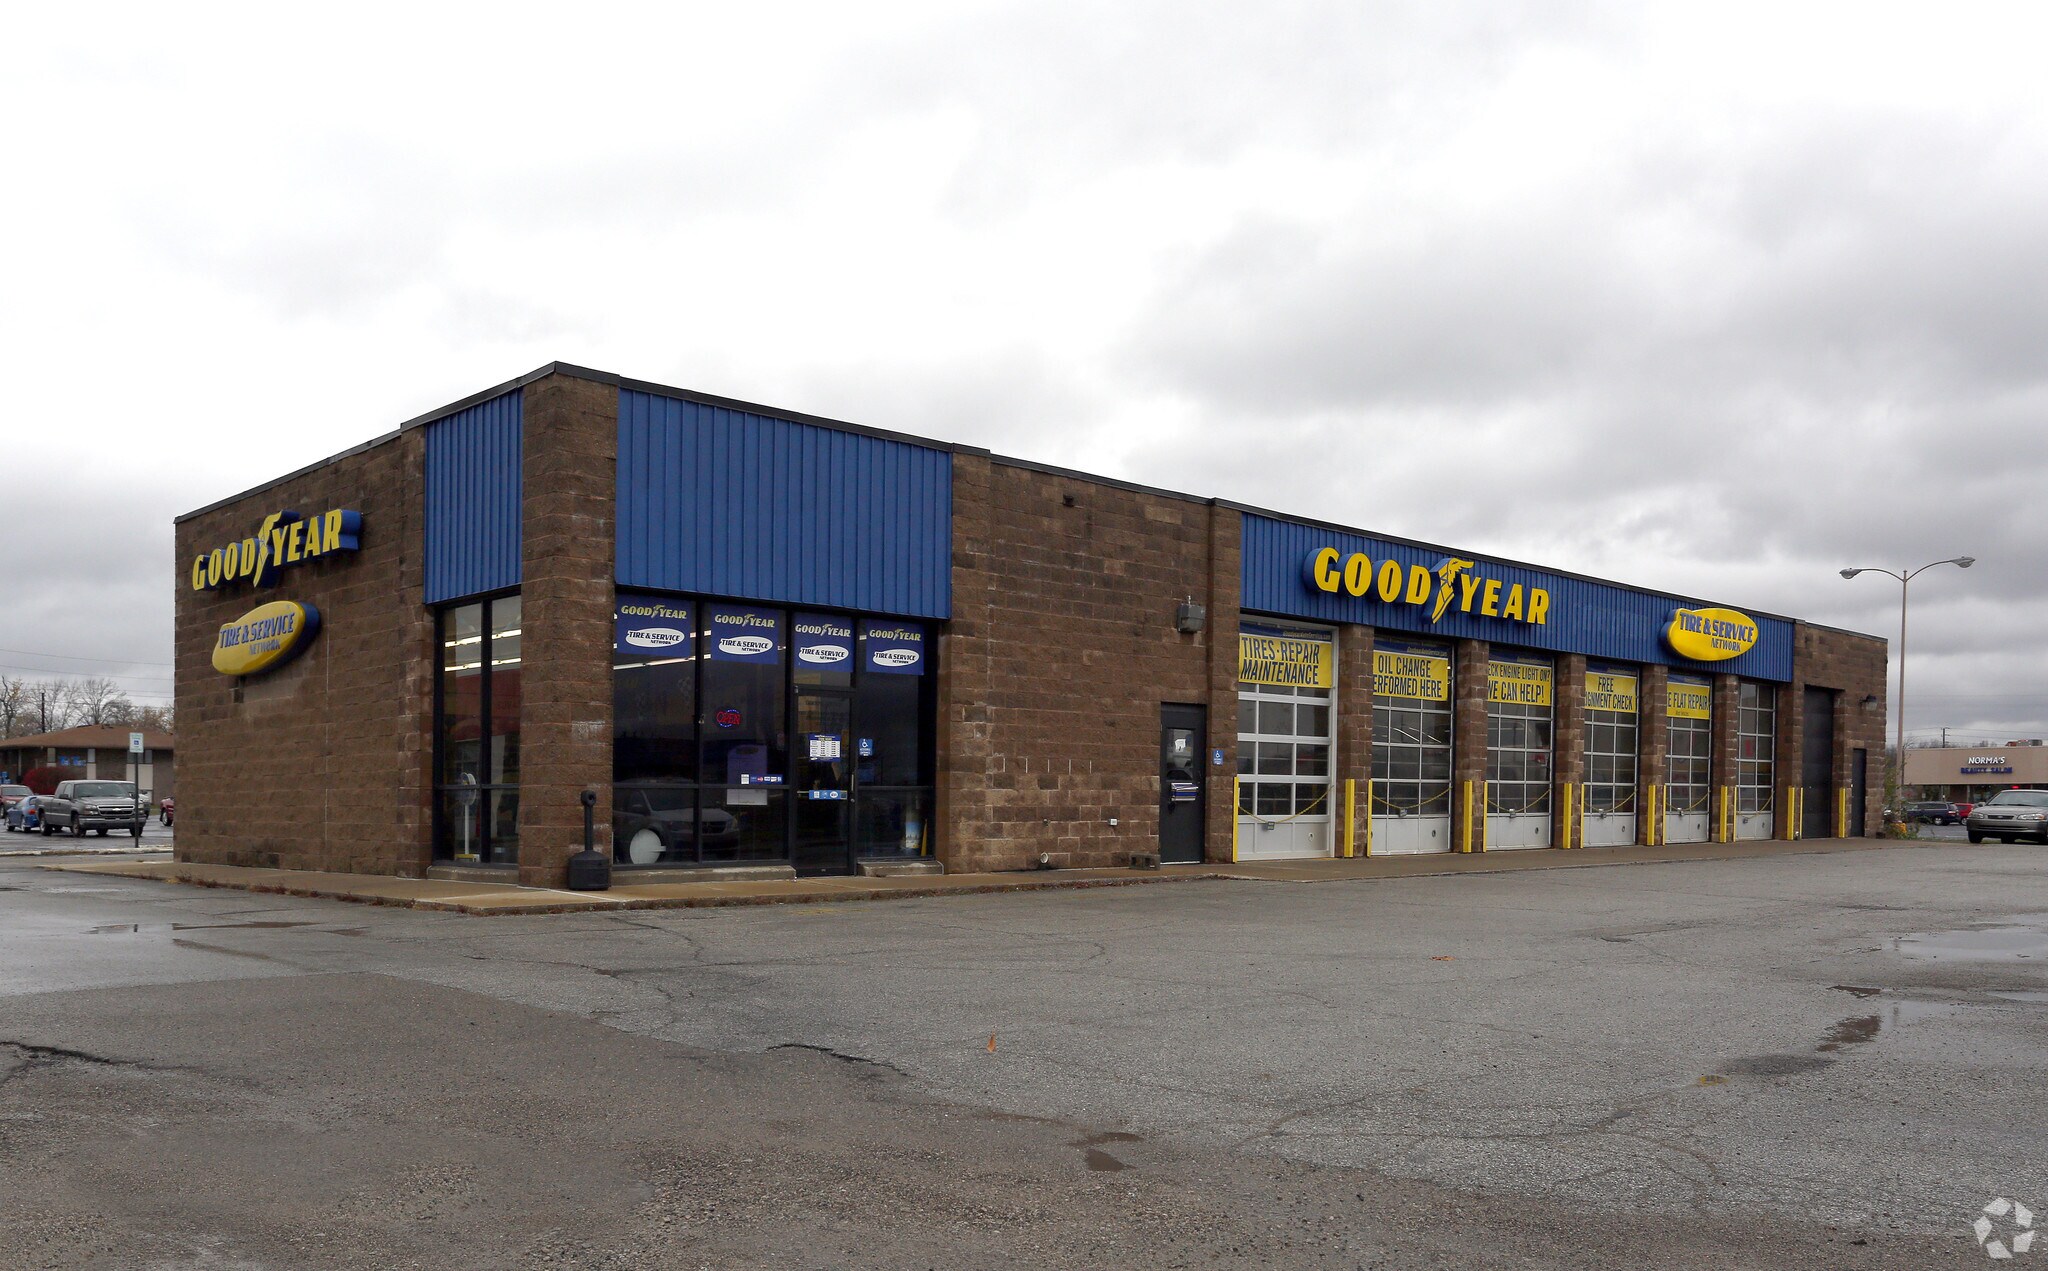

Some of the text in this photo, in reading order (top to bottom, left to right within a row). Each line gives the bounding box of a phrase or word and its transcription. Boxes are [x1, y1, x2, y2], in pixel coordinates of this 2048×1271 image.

[192, 509, 342, 590] GOODYEAR
[1314, 547, 1549, 625] GOODYEAR
[621, 604, 687, 619] GOODYEAR
[714, 614, 775, 628] GOODYEAR
[1680, 612, 1754, 642] TIRE & SERVICE
[220, 612, 295, 648] TIRE & SERVICE
[629, 631, 644, 639] TIRE
[651, 633, 680, 641] SERVICE
[795, 624, 851, 637] GOODYEAR
[869, 629, 921, 641] GOODYEAR
[249, 639, 280, 655] NETWORK
[742, 641, 768, 649] SERVICE
[1711, 637, 1741, 652] NETWORK
[820, 650, 845, 658] SERVICE
[1240, 659, 1319, 685] MAINTENANCE
[1378, 655, 1431, 678] OIL CHANGE
[1500, 665, 1520, 679] ENGINE
[1522, 667, 1538, 680] LIGHT
[1540, 669, 1550, 682] ON?
[1373, 675, 1442, 698] ERFORMED HERE
[1501, 681, 1517, 701] CAN
[1520, 683, 1544, 703] HELP!
[1598, 676, 1614, 692] FREE
[1585, 691, 1632, 710] IGNMENT CHECK
[1673, 692, 1686, 708] FLAT
[1688, 693, 1709, 710] REPAIR
[717, 711, 740, 725] OPEN
[1968, 756, 2005, 764] NORMA'S
